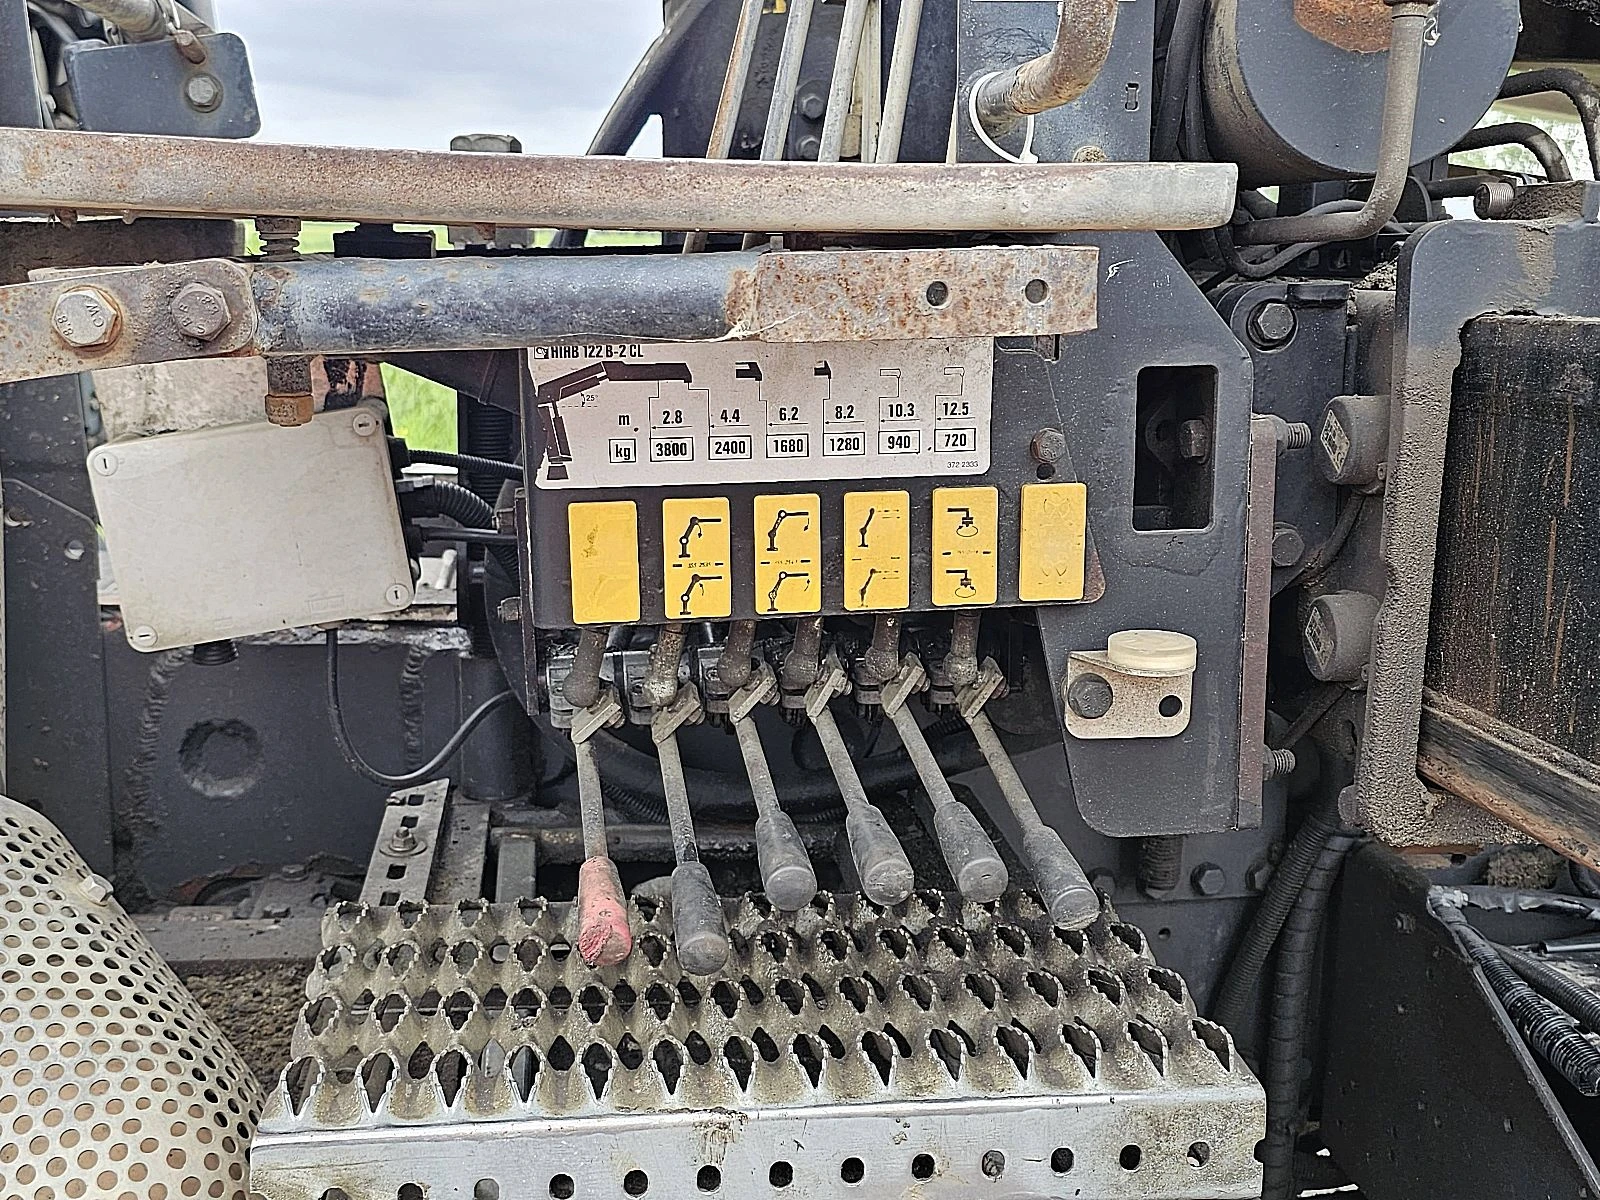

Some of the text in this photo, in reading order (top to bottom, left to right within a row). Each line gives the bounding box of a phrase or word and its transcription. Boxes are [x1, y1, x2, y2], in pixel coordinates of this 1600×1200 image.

[57, 315, 74, 337] 8.8
[583, 345, 604, 359] 122
[606, 344, 627, 358] B-2
[630, 344, 644, 358] CL
[662, 410, 683, 424] 2.8
[720, 408, 741, 423] 4.4
[779, 406, 799, 421] 6.2
[835, 405, 855, 419] 8.2
[888, 403, 915, 418] 10.3
[942, 402, 969, 416] 12.5
[615, 433, 967, 461] kg 3800 2400 1680 1280 940 720
